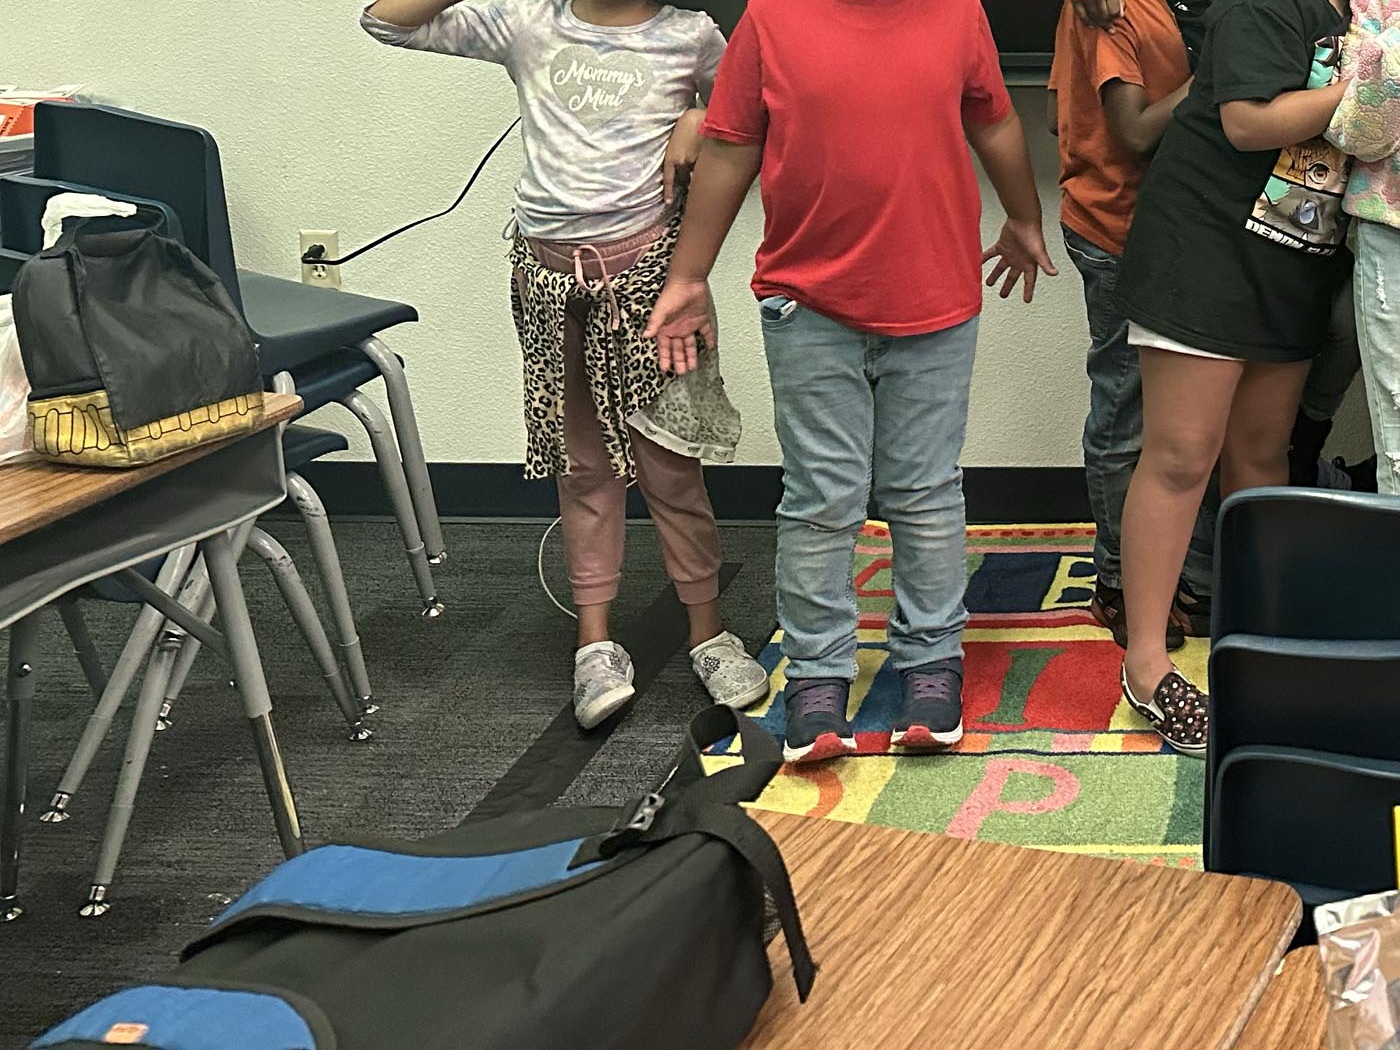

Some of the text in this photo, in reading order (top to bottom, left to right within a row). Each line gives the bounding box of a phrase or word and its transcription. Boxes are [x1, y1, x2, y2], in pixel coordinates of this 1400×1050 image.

[553, 60, 646, 96] Mommy's
[568, 85, 624, 112] Mini
[945, 758, 1081, 840] P
